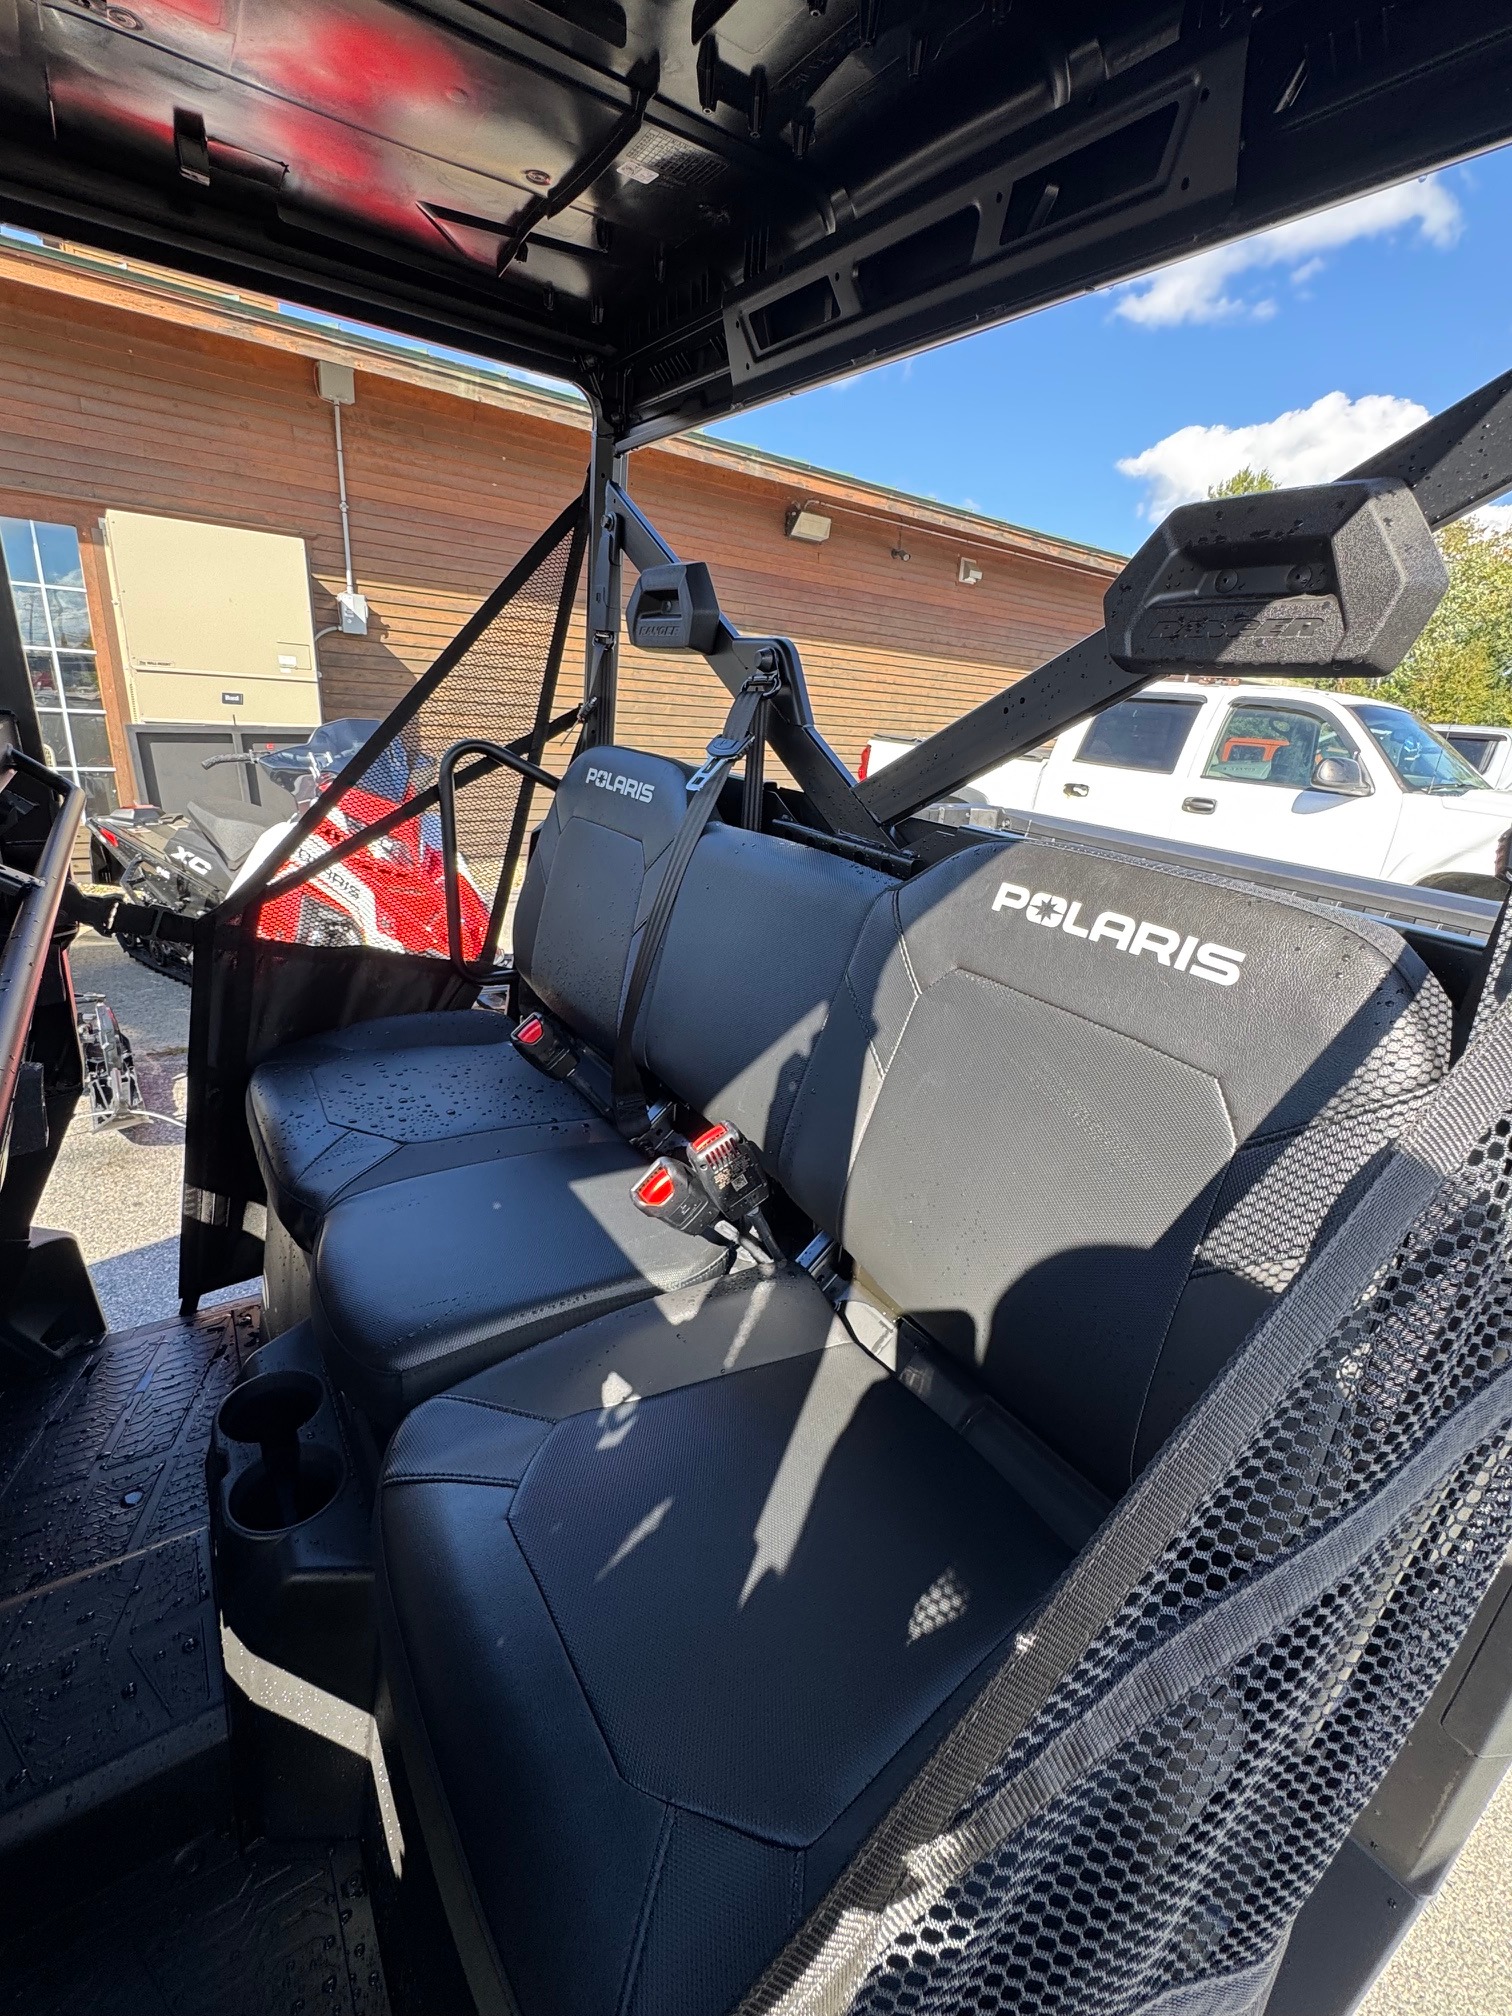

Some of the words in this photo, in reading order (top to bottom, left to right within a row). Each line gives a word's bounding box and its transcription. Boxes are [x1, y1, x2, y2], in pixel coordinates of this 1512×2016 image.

[1148, 617, 1324, 638] RANGER
[585, 767, 655, 804] POLARIS
[170, 845, 212, 876] XC
[991, 882, 1247, 986] POLARIS
